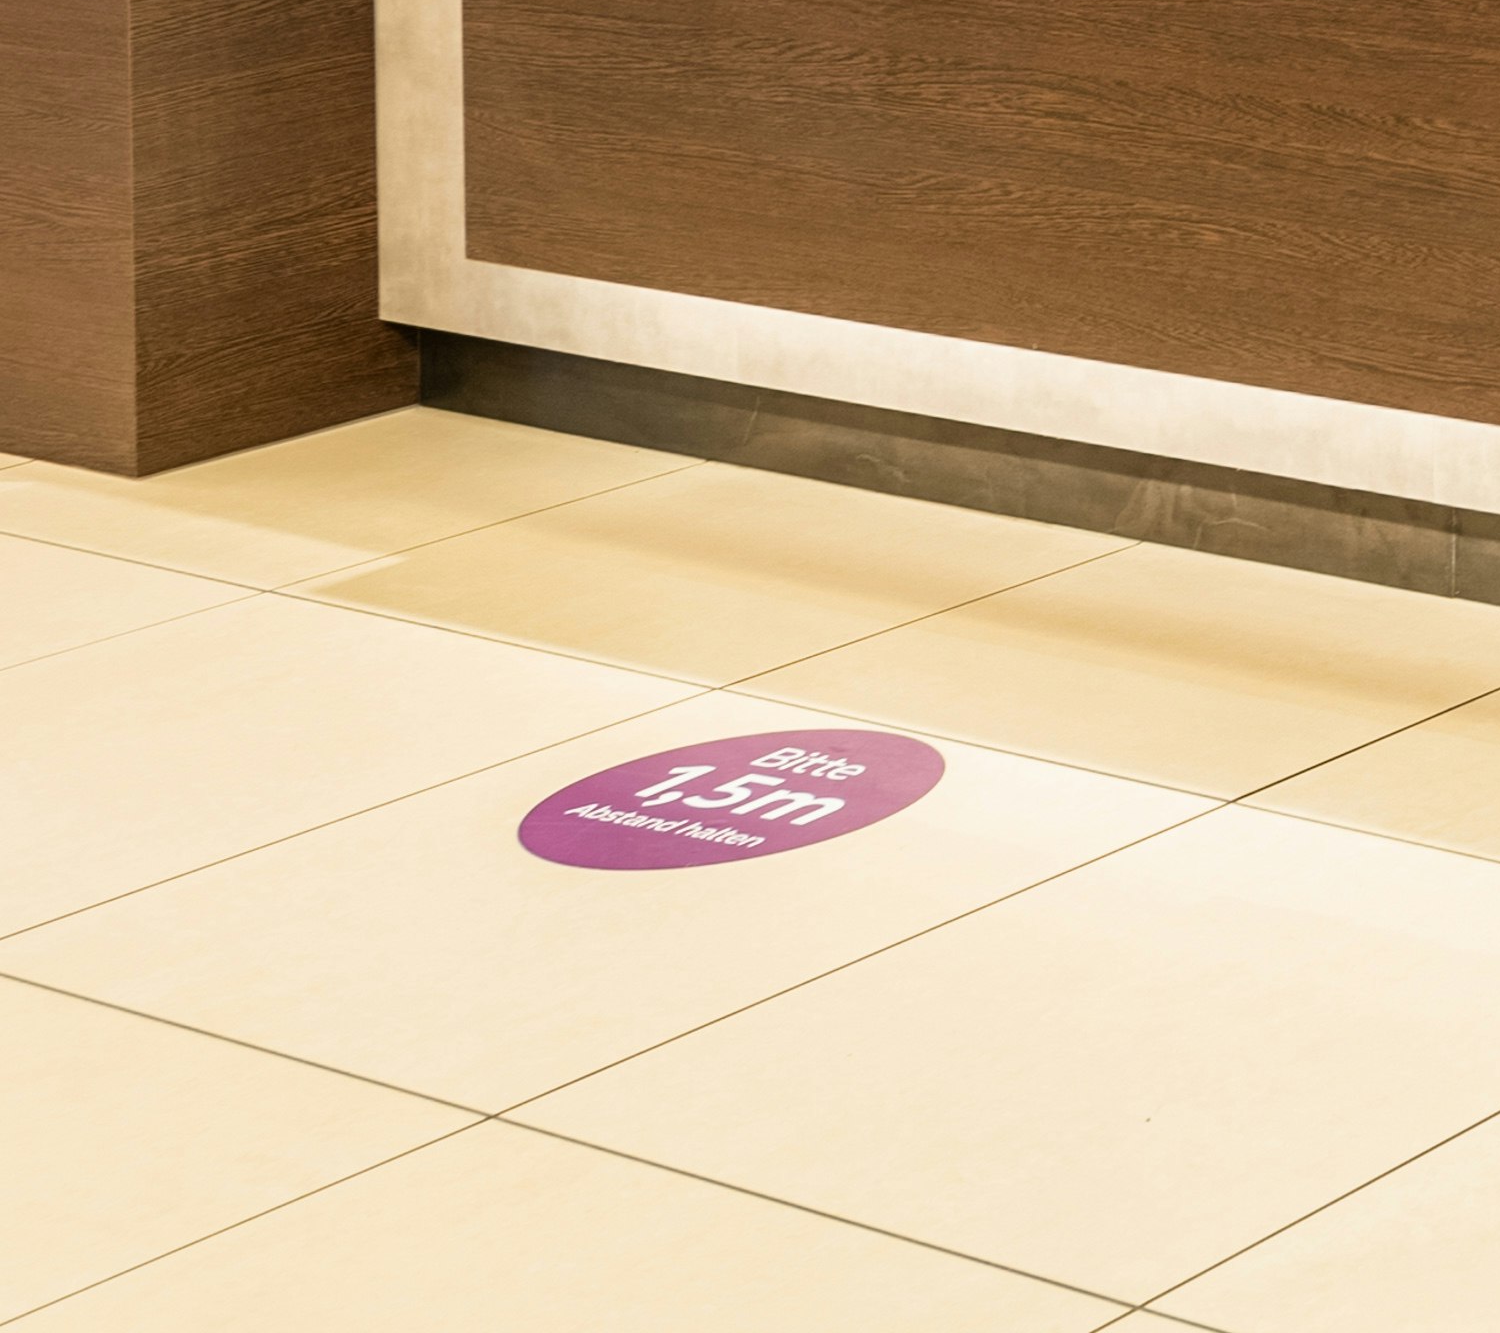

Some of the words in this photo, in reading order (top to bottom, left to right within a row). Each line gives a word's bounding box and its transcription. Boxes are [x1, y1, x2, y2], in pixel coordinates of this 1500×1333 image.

[750, 747, 867, 780] Bitte
[634, 765, 846, 825] 1,5m
[564, 803, 682, 834] Abstand
[675, 820, 766, 848] halten
